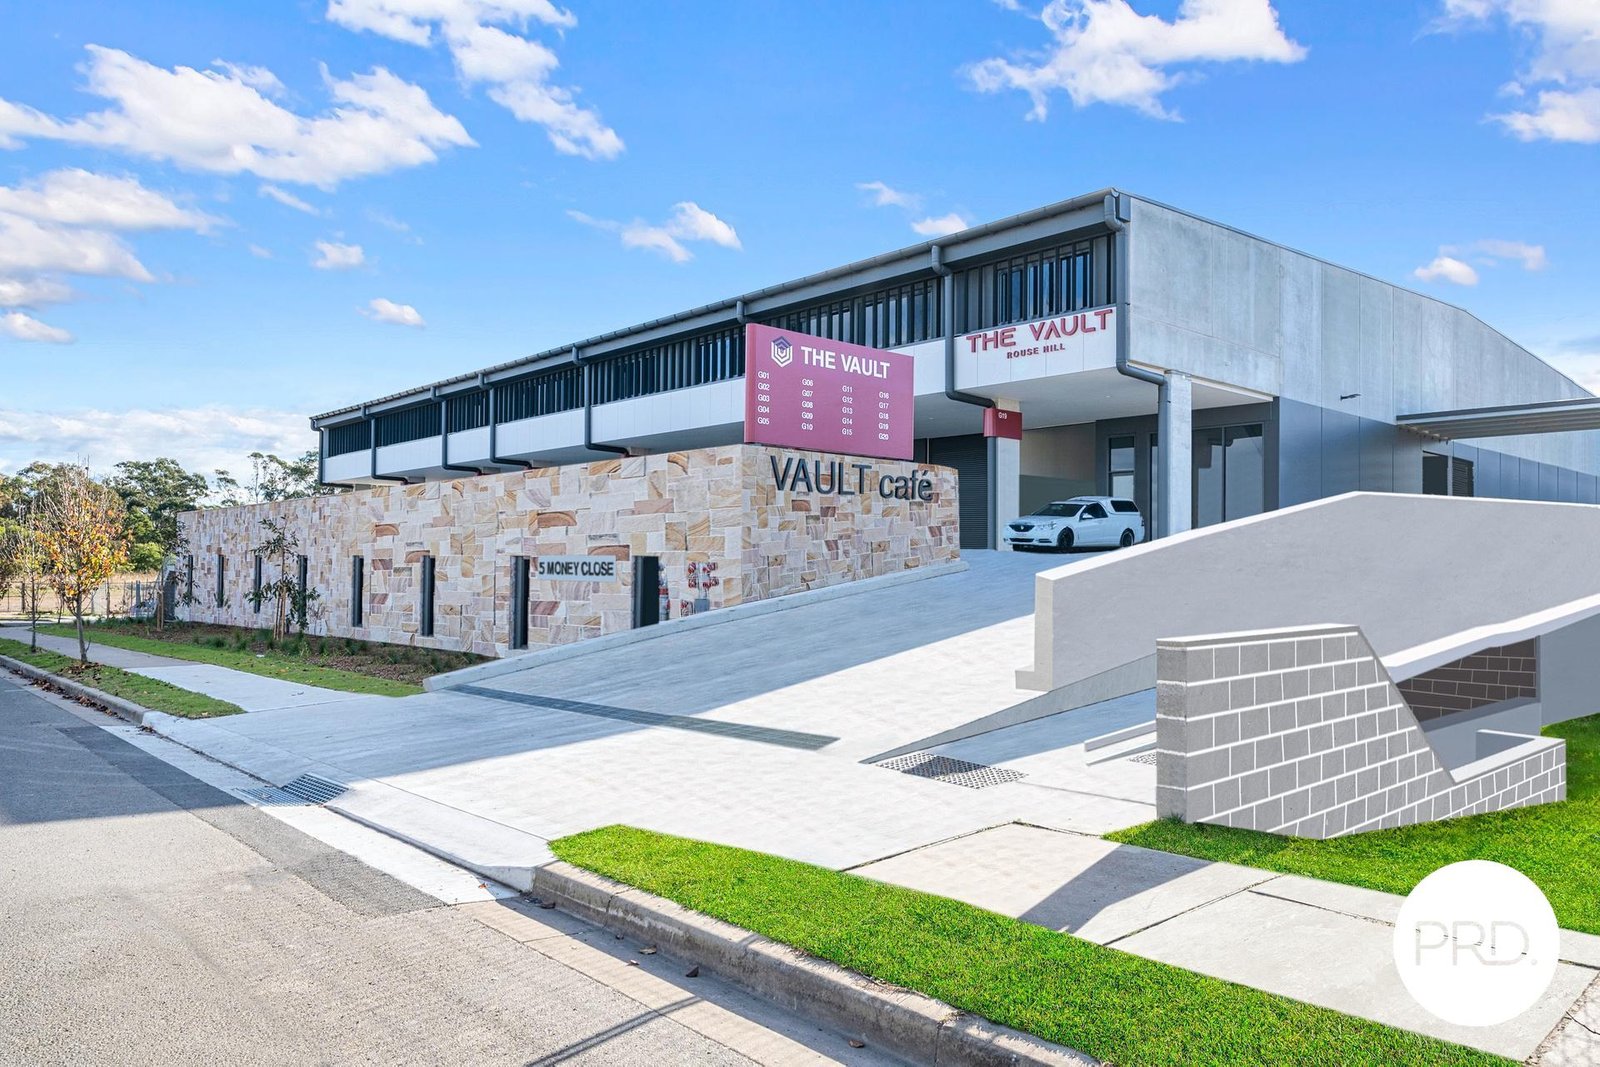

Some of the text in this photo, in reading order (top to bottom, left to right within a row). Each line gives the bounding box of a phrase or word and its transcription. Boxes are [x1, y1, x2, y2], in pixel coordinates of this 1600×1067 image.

[966, 309, 1113, 353] THE VAULT
[1006, 343, 1066, 359] ROUSE HILL
[801, 346, 890, 379] THE VAULT
[758, 371, 770, 379] G01
[802, 378, 813, 386] G06
[758, 382, 770, 391] G02
[842, 385, 853, 393] G11
[758, 394, 770, 402] G03
[802, 390, 813, 398] G07
[842, 396, 853, 404] G12
[758, 405, 770, 413] G04
[802, 401, 813, 409] G08
[802, 412, 813, 420] G09
[879, 412, 889, 420] G18
[758, 417, 770, 425] G05
[802, 423, 813, 431] G10
[842, 428, 853, 436] G15
[770, 456, 933, 500] VAULT café
[539, 561, 614, 576] 5 MONEY CLOSE
